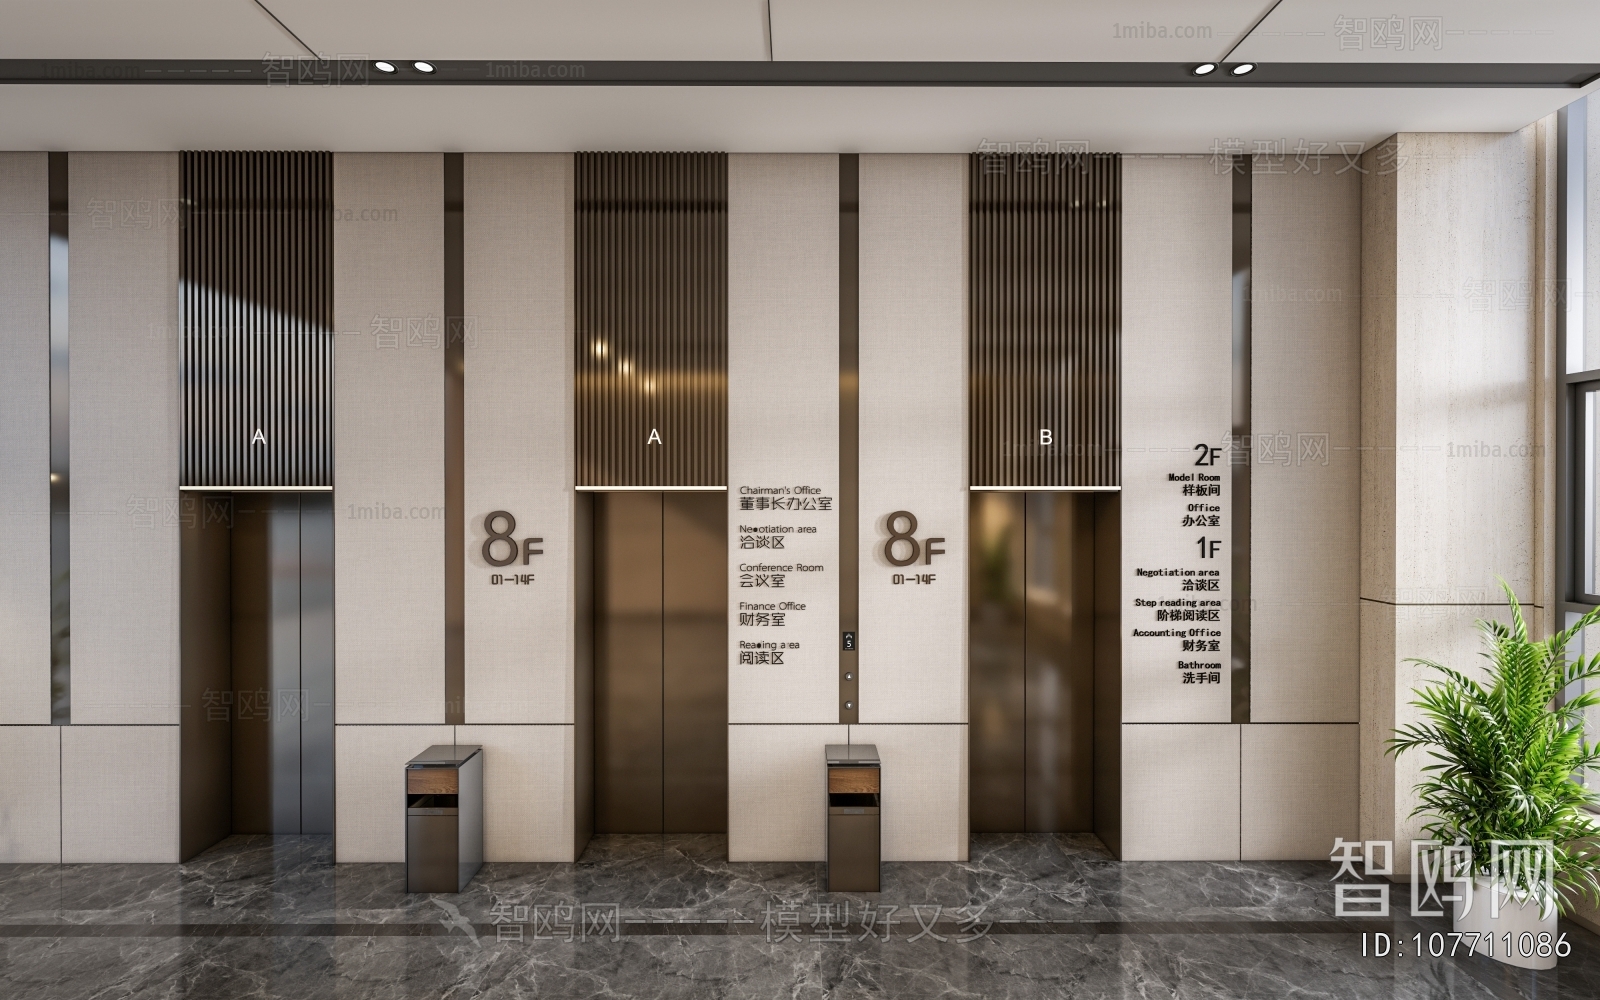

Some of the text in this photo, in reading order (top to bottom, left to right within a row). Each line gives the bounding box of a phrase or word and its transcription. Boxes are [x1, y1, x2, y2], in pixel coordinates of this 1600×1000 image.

[252, 428, 267, 445] A
[647, 428, 662, 445] A
[1040, 429, 1053, 445] B
[1194, 443, 1222, 466] 2F
[1168, 473, 1221, 481] Model Room
[739, 485, 822, 495] Chairman's Office
[1182, 484, 1221, 497] 样板间
[739, 497, 833, 511] 董事长办公室
[1188, 503, 1221, 512] Office
[1182, 514, 1221, 527] 办公室
[797, 526, 817, 534] area
[482, 510, 544, 567] 8F
[740, 535, 785, 550] 洽谈区
[884, 510, 946, 567] 8F
[1197, 536, 1222, 559] 1F
[739, 563, 824, 572] Conference Room
[1136, 568, 1196, 577] Negotiation
[740, 573, 785, 588] 会议室
[1182, 579, 1221, 592] 洽谈区
[739, 602, 807, 611] Finance Office
[1135, 598, 1157, 608] Step
[1160, 598, 1197, 608] reading
[739, 612, 786, 627] 财务室
[1156, 609, 1221, 622] 阶梯阅读区
[1133, 628, 1222, 638] Accounting Office
[1182, 639, 1221, 652] 财务室
[739, 651, 784, 665] 阅读区
[1178, 661, 1222, 670] Bathroom
[1182, 671, 1221, 684] 洗手间
